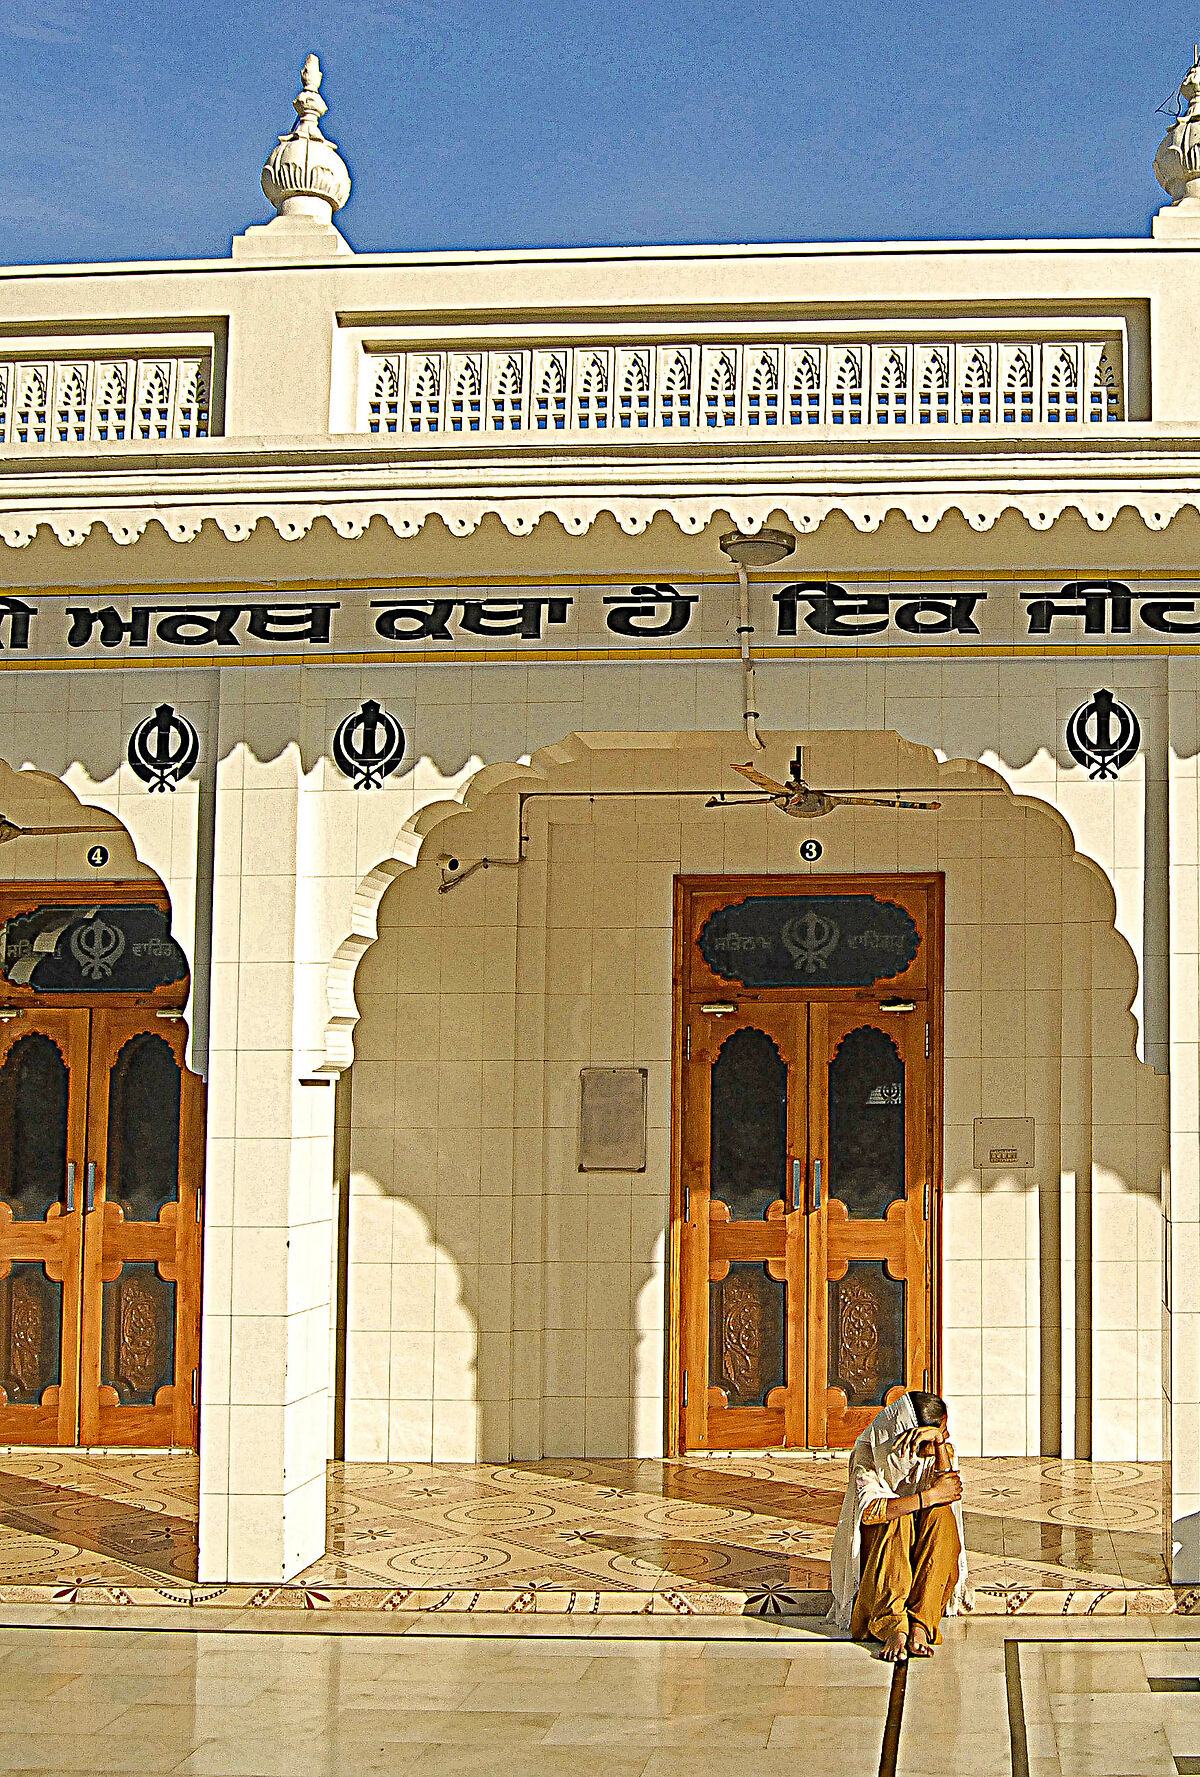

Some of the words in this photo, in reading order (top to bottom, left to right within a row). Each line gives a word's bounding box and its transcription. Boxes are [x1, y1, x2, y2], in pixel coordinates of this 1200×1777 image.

[66, 602, 340, 647] ਅਕਥ
[370, 597, 574, 640] ਕਥਾ
[602, 584, 699, 638] ਹੈ
[772, 581, 988, 636] ਇਕ
[92, 848, 103, 864] 4
[805, 842, 817, 859] 3
